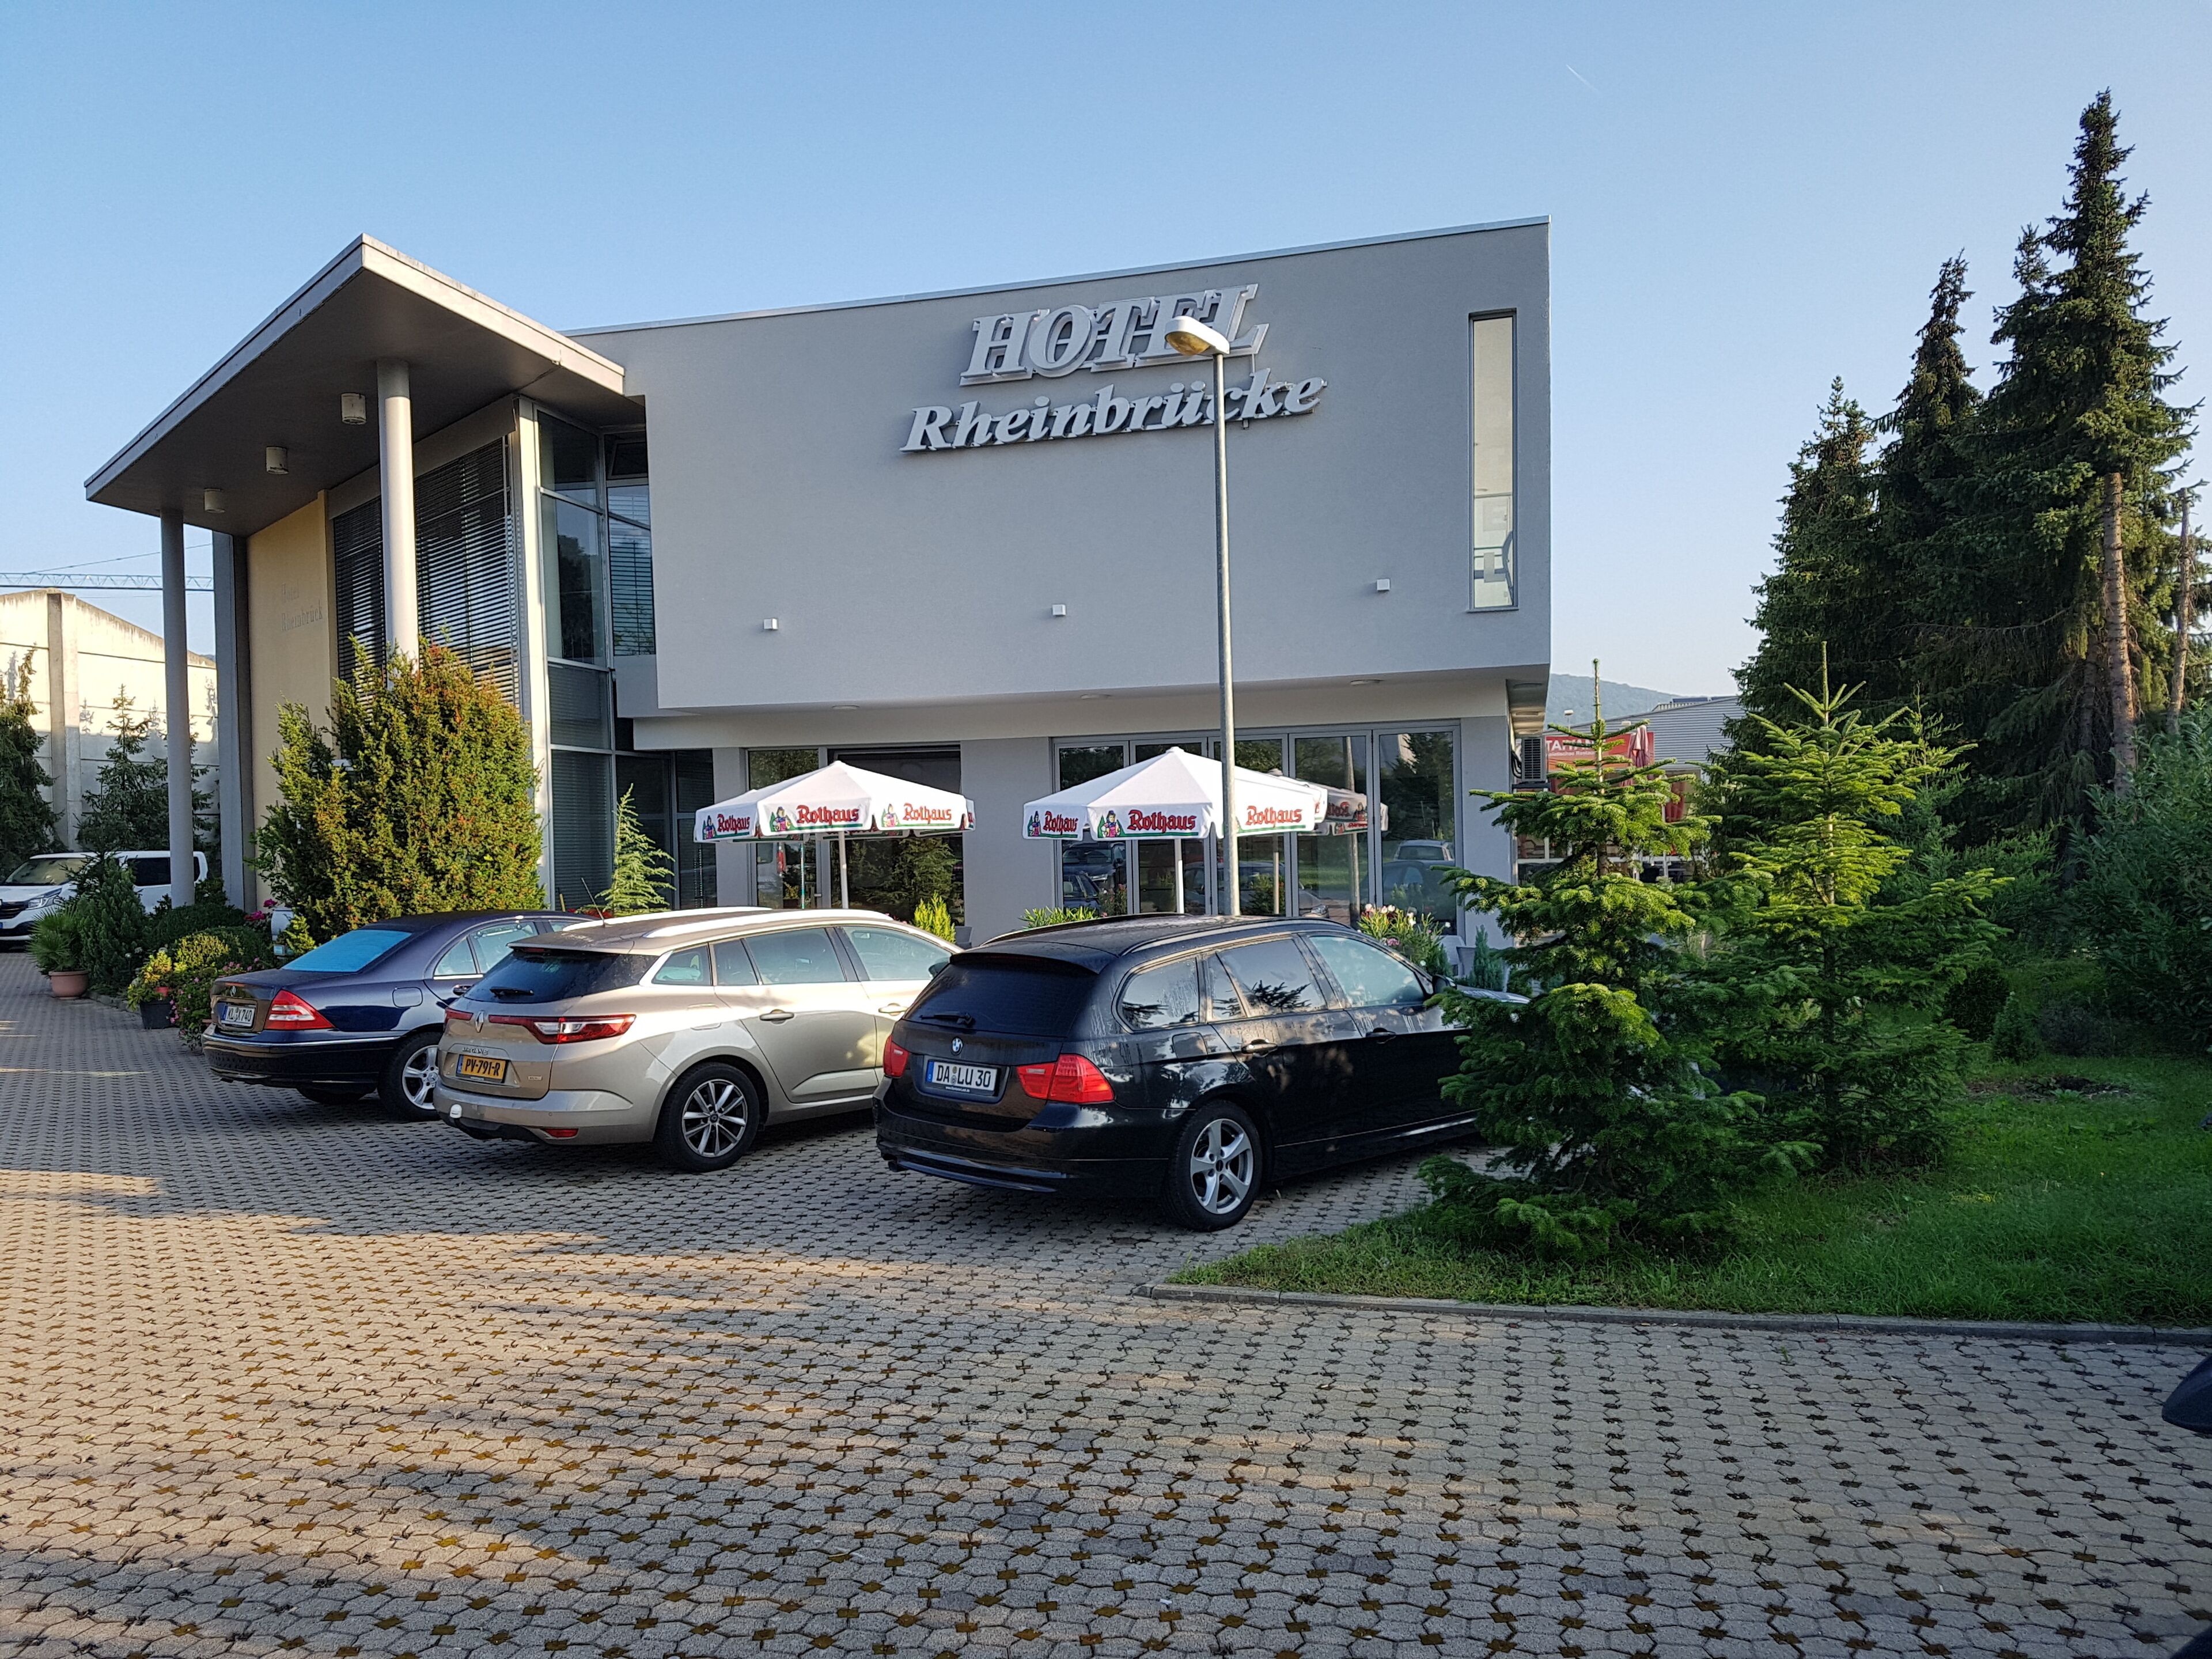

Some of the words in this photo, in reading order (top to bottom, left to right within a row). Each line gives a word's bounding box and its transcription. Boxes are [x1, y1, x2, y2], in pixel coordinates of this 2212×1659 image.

[960, 283, 1269, 386] HOTEL
[900, 368, 1327, 453] Rheinbrücke
[717, 813, 750, 834] Rothaus
[796, 805, 859, 825] Rothaus
[903, 802, 952, 824] Rothaus
[1043, 810, 1078, 835] Rothaus
[1127, 809, 1197, 834] Rothaus
[1245, 805, 1303, 828] Rothaus
[465, 1059, 500, 1076] PV-791-R
[936, 1065, 950, 1082] DA
[957, 1067, 974, 1085] LU
[975, 1070, 991, 1088] 30
